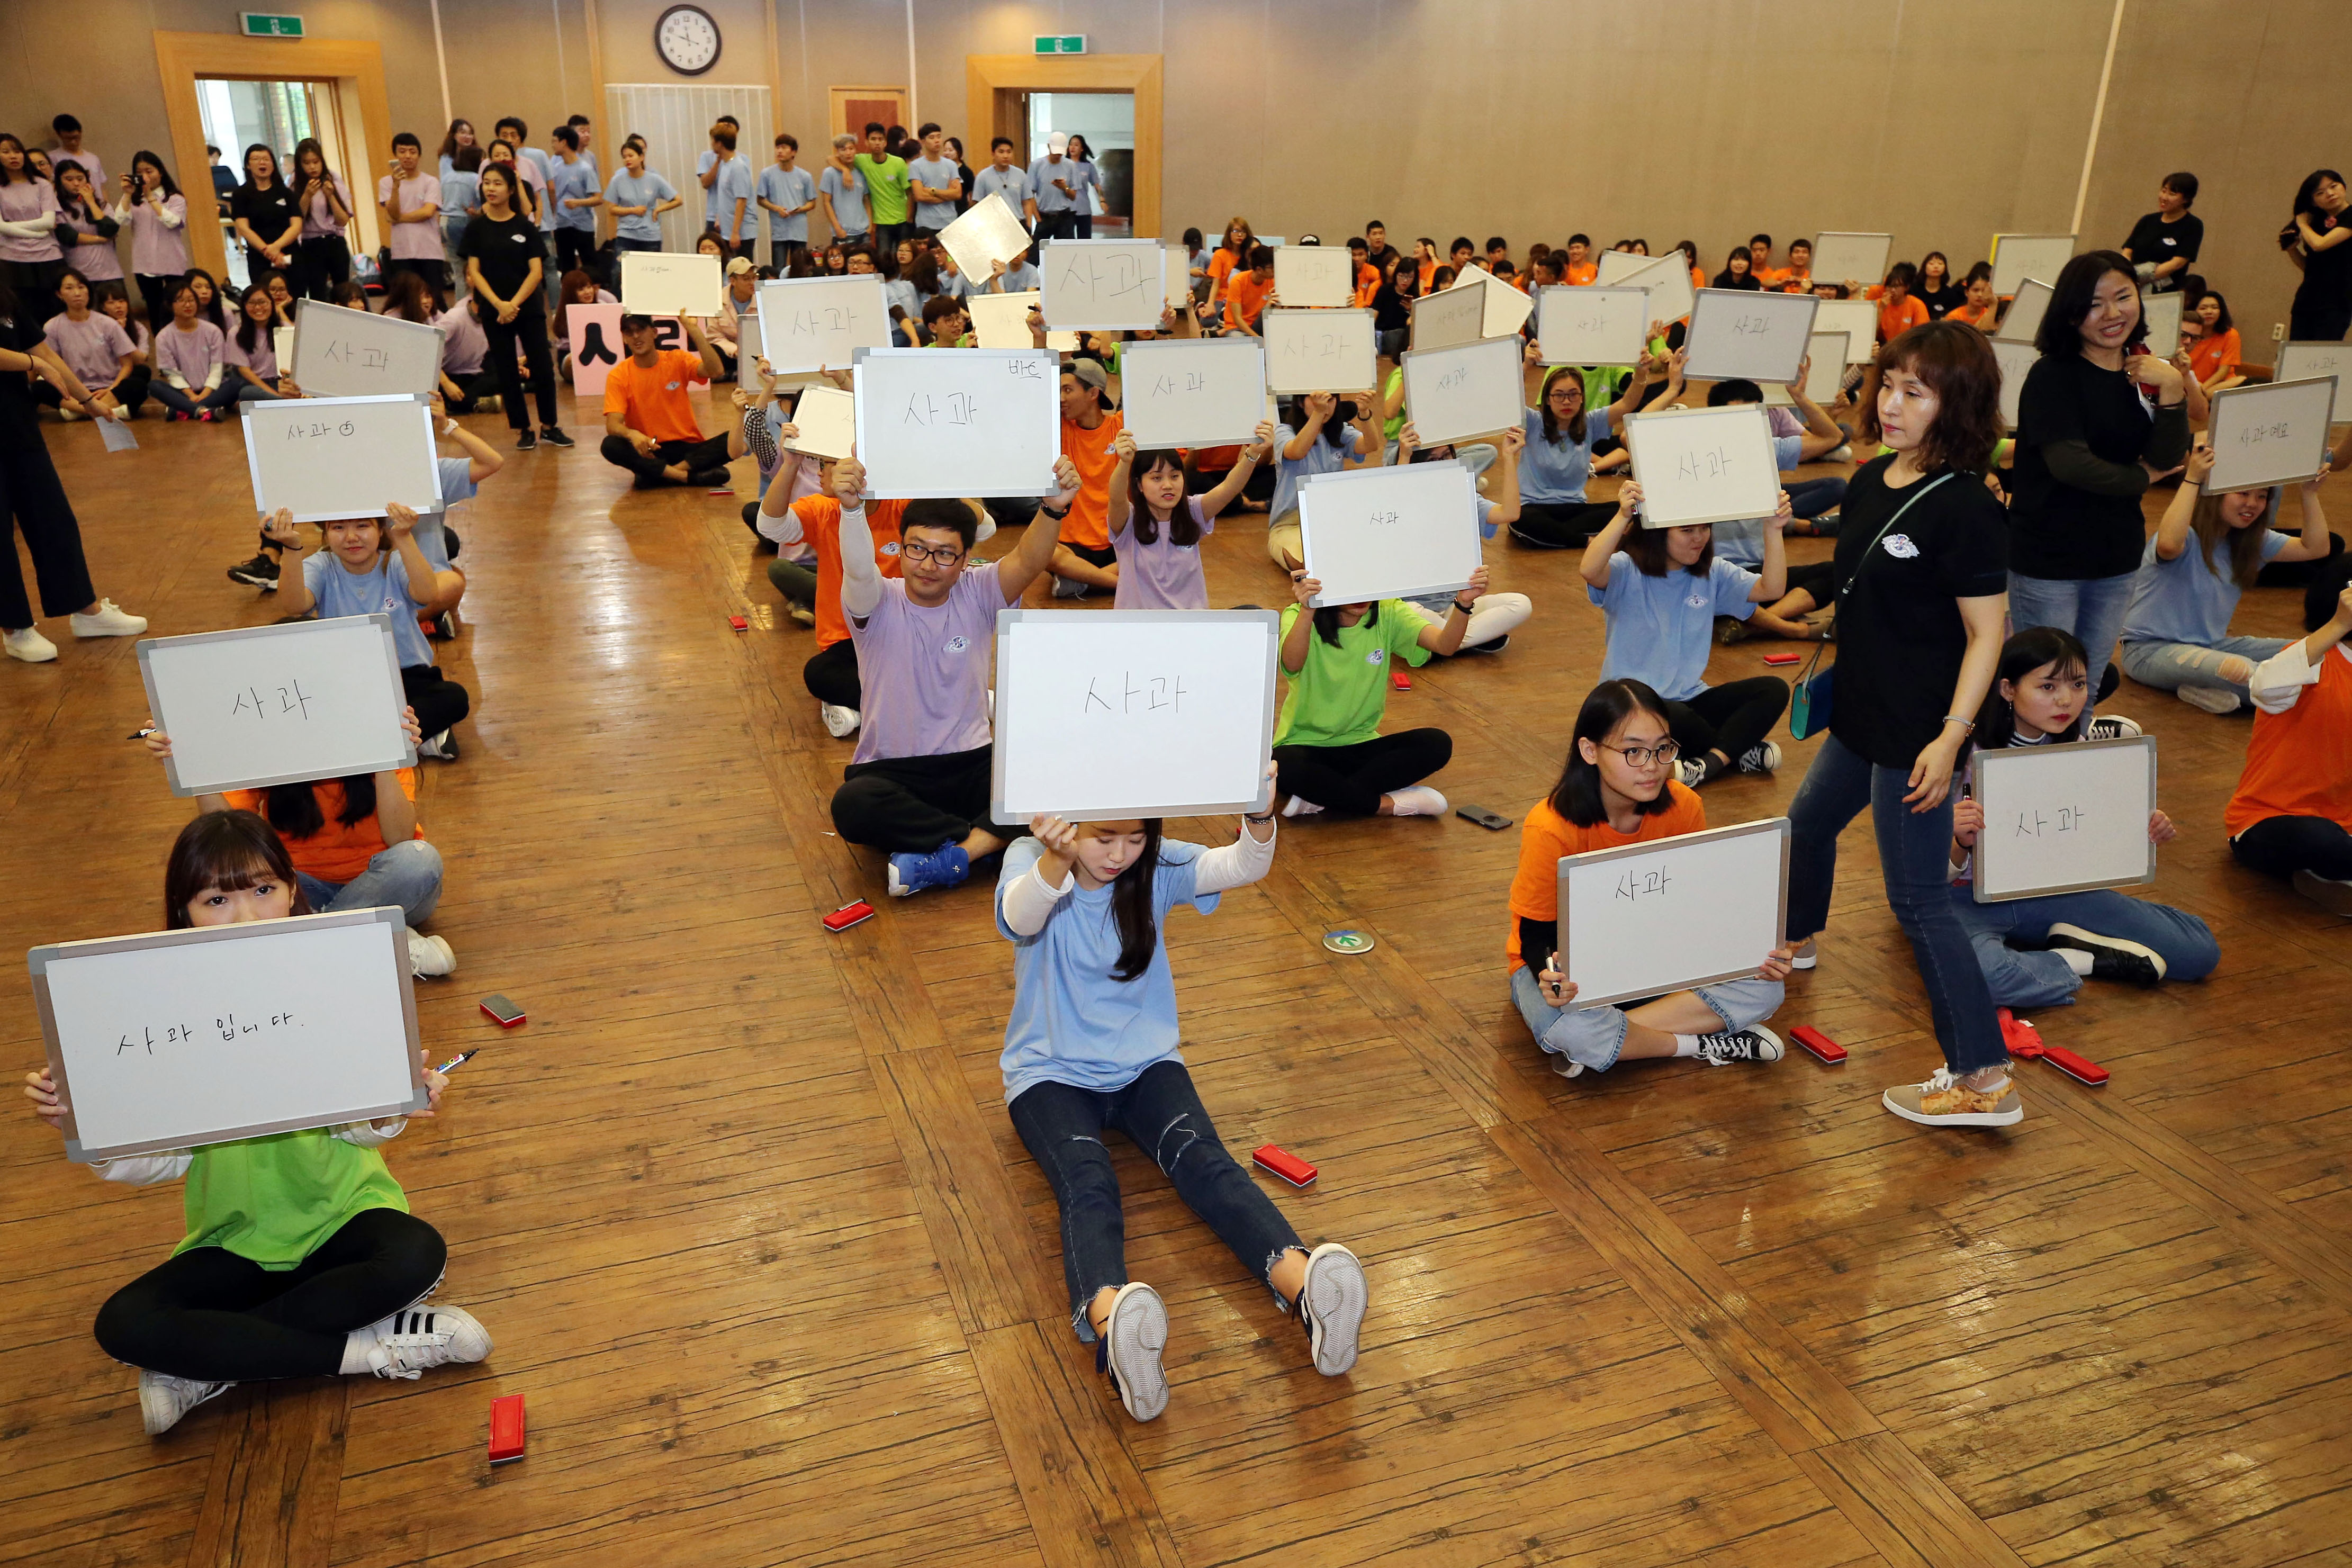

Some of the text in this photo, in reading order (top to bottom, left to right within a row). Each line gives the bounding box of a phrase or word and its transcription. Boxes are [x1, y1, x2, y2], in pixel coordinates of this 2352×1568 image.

[1059, 253, 1156, 304] 사과
[793, 307, 858, 335] 사과
[1577, 313, 1610, 334] 사과
[1733, 316, 1770, 339] 사과
[325, 340, 389, 371] 사과
[1284, 334, 1351, 359] 사과
[2305, 357, 2338, 370] 사과
[1152, 372, 1205, 398] 사과
[1436, 366, 1468, 391] 사과
[904, 391, 978, 426] 사과
[288, 423, 331, 440] 사과
[1679, 446, 1732, 480] 사과
[1369, 511, 1399, 525] 사과
[232, 679, 312, 720] 사과
[1085, 670, 1187, 714] 사과
[2016, 803, 2085, 839] 사과
[1615, 864, 1671, 901] 사과
